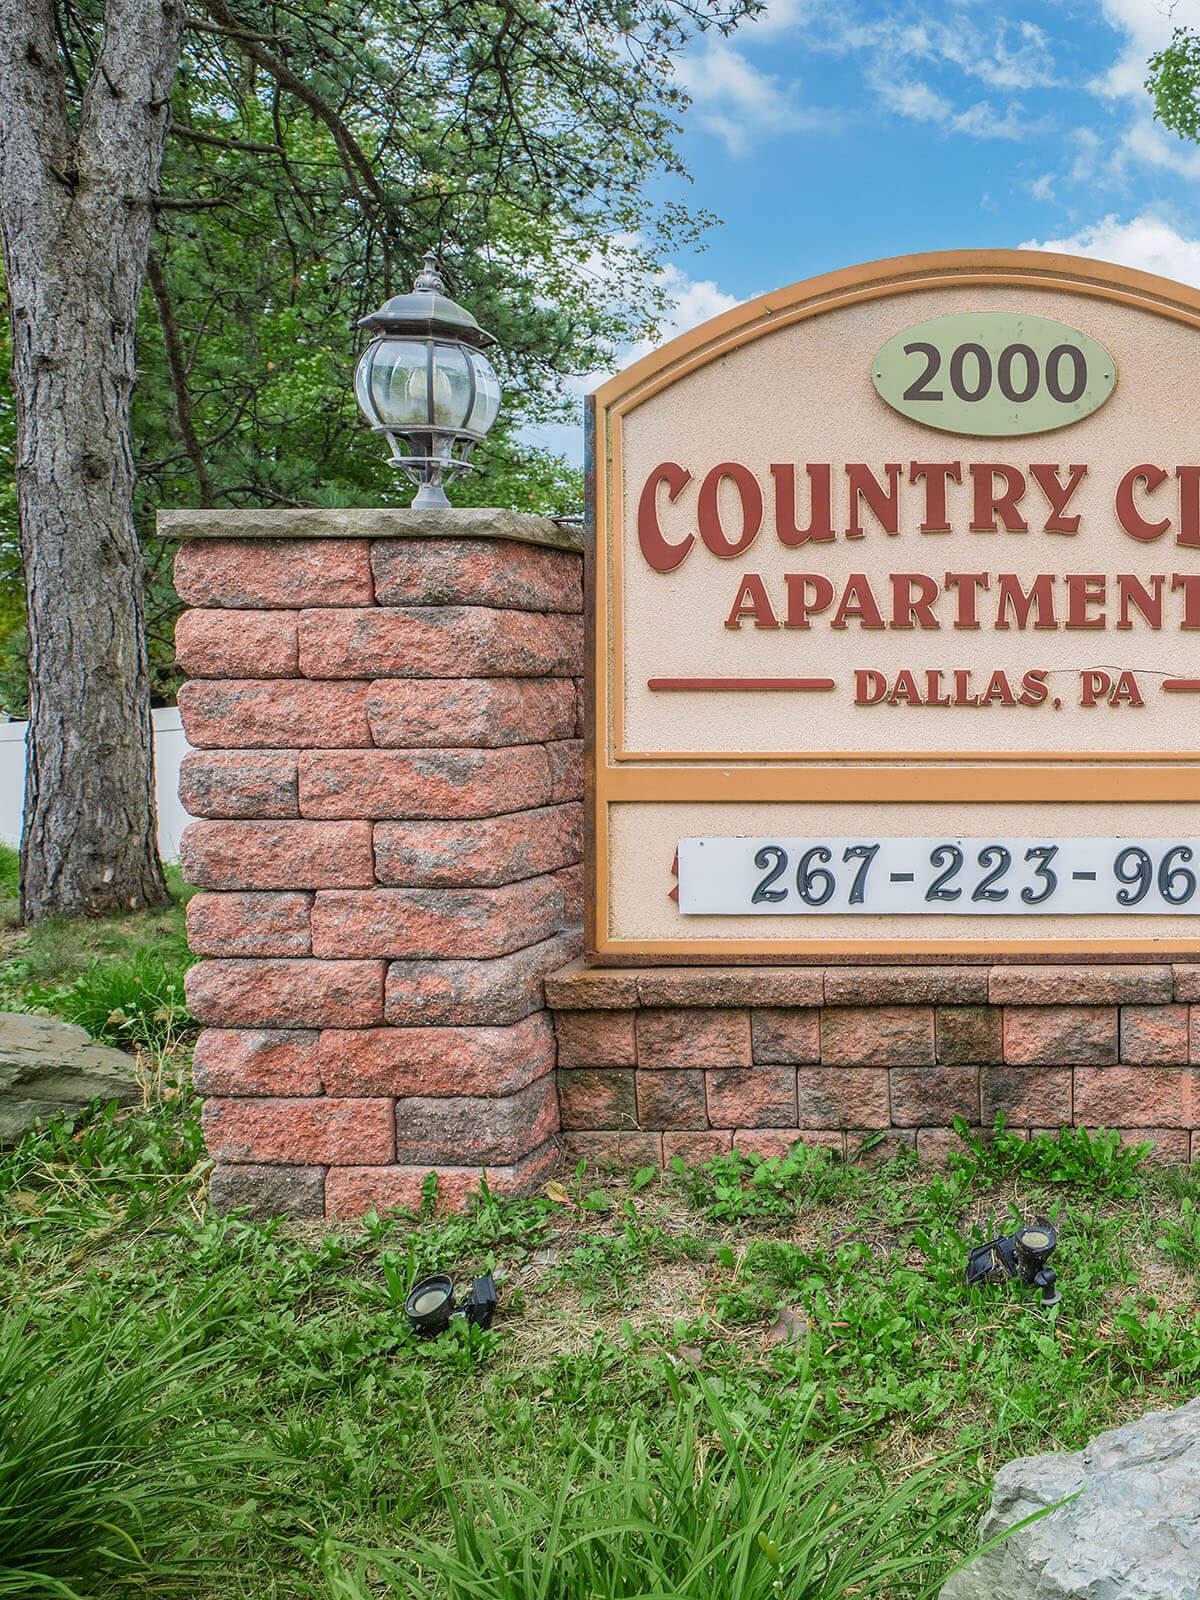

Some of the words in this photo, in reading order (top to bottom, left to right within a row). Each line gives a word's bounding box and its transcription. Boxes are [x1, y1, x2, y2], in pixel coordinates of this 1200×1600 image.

[902, 342, 1088, 403] 2000
[638, 461, 1089, 573] COUNTRY
[854, 669, 1062, 710] DALLAS,
[1080, 670, 1145, 708] PA
